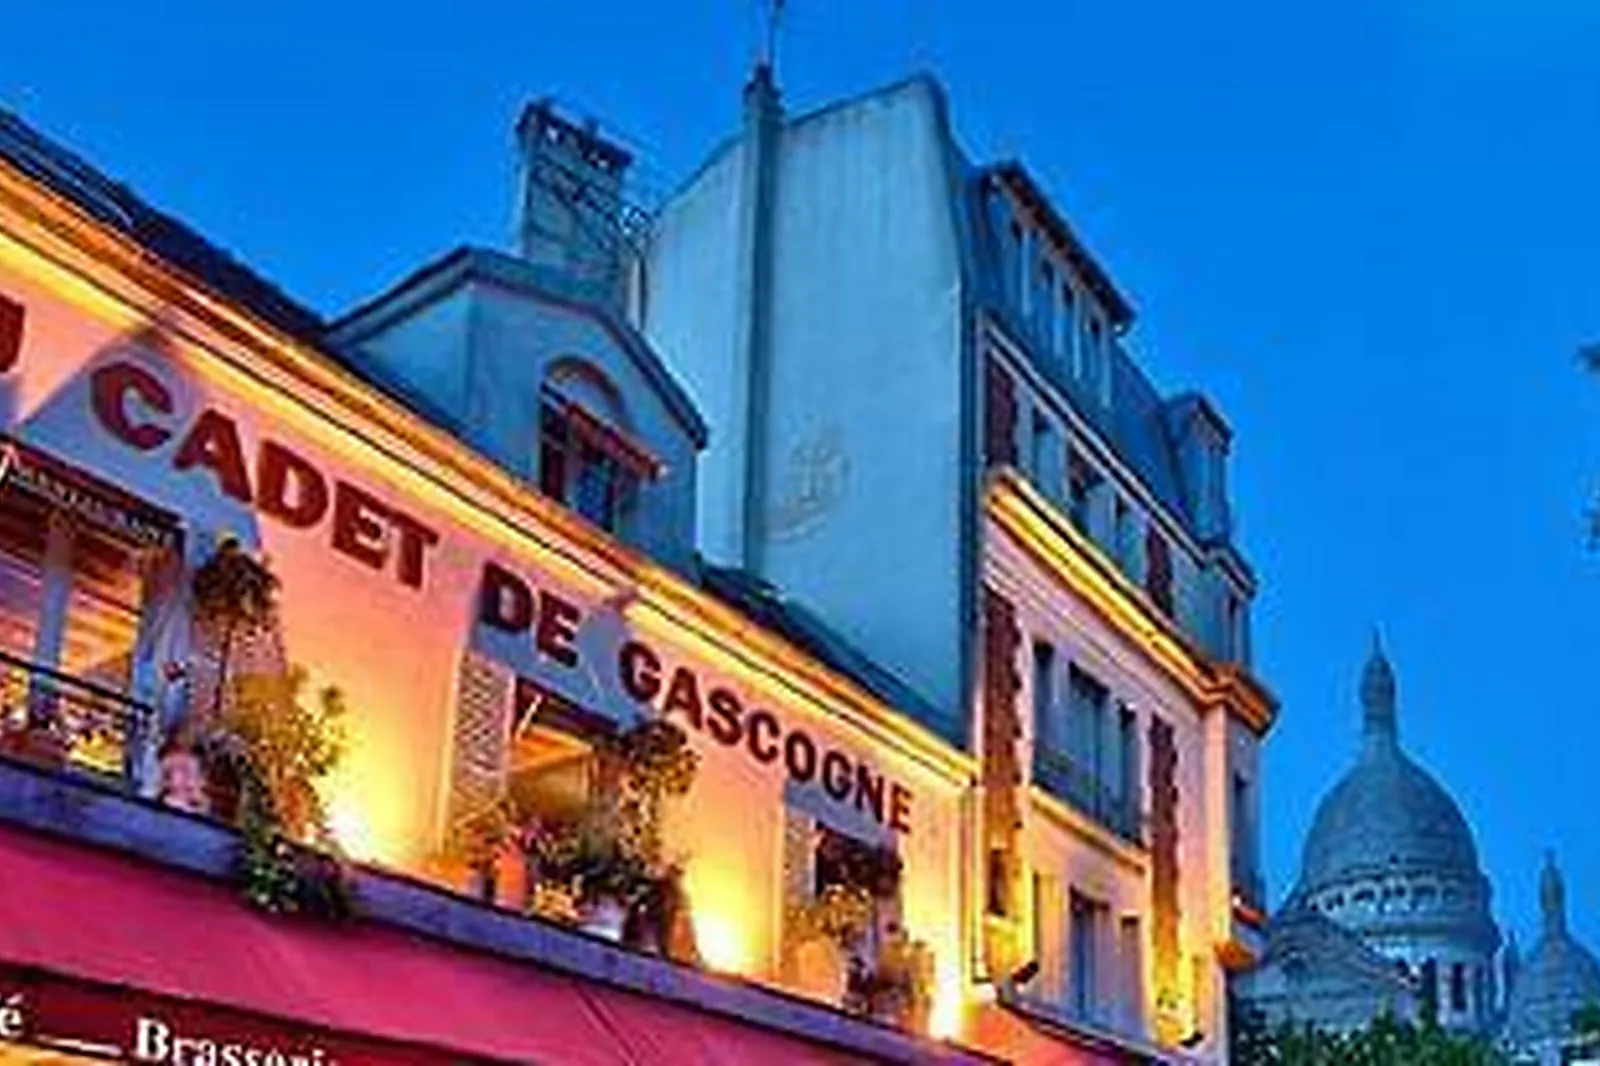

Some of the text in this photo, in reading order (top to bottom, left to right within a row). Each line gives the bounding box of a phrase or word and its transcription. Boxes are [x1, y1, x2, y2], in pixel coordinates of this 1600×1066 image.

[90, 361, 439, 589] CADET
[481, 561, 581, 667] DE
[618, 640, 914, 834] GASCOGNE
[133, 1017, 338, 1066] Brasse
